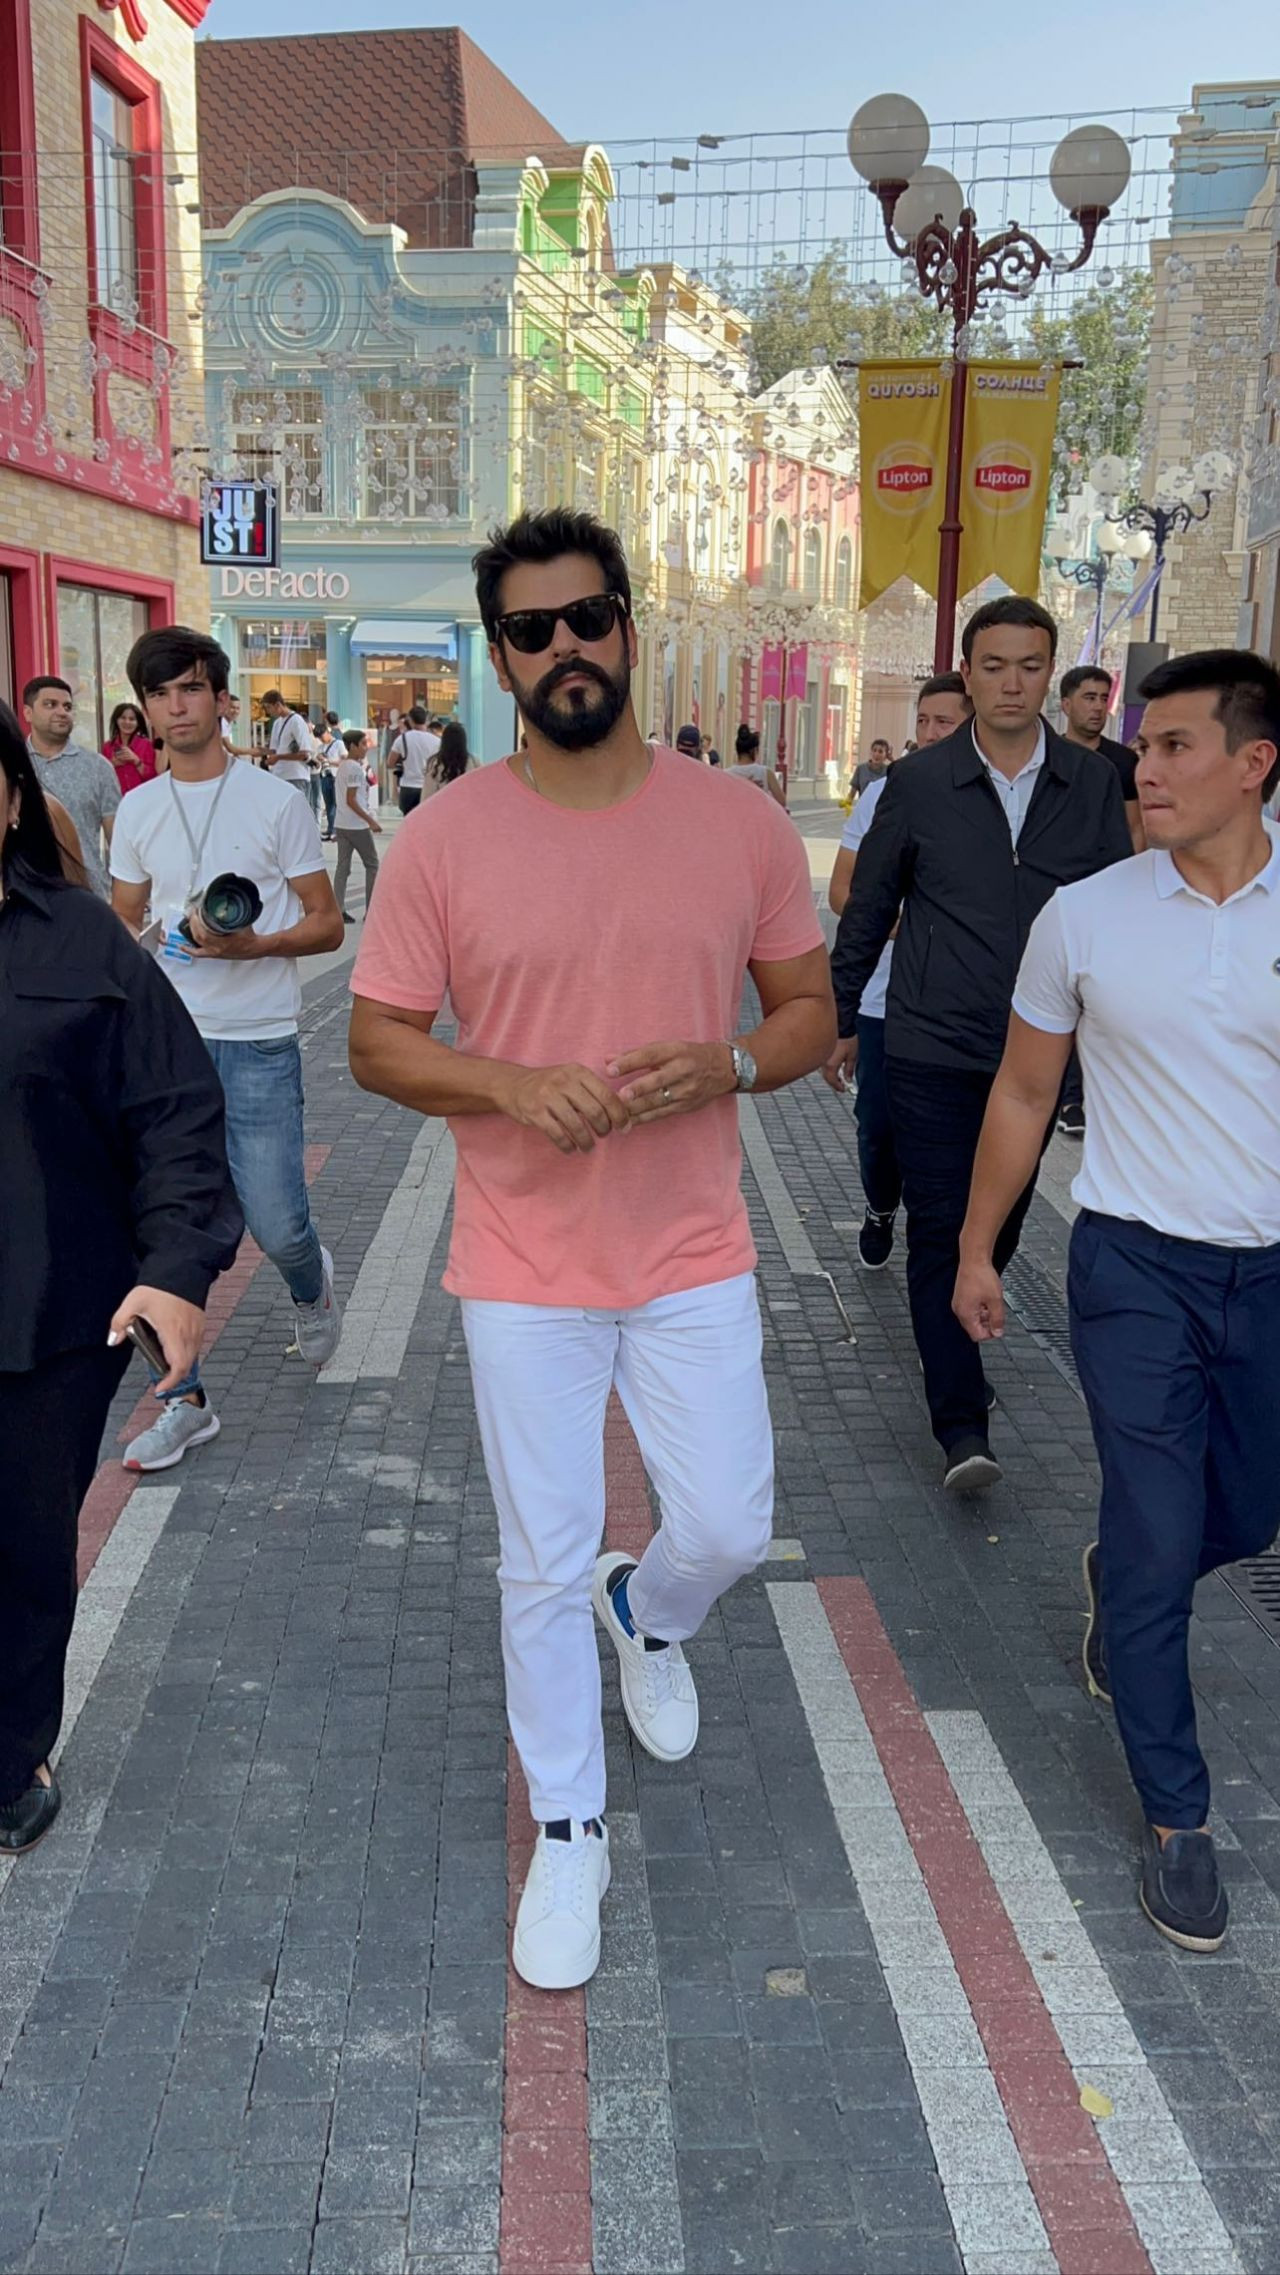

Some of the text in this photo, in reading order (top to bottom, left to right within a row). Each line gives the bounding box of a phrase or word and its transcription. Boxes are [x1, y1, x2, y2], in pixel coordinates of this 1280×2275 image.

[868, 382, 939, 398] QUYOSH
[882, 471, 929, 487] Lipton
[979, 470, 1026, 487] Lipton
[212, 489, 256, 521] JU
[213, 520, 264, 555] ST!
[221, 566, 350, 599] DeFacto
